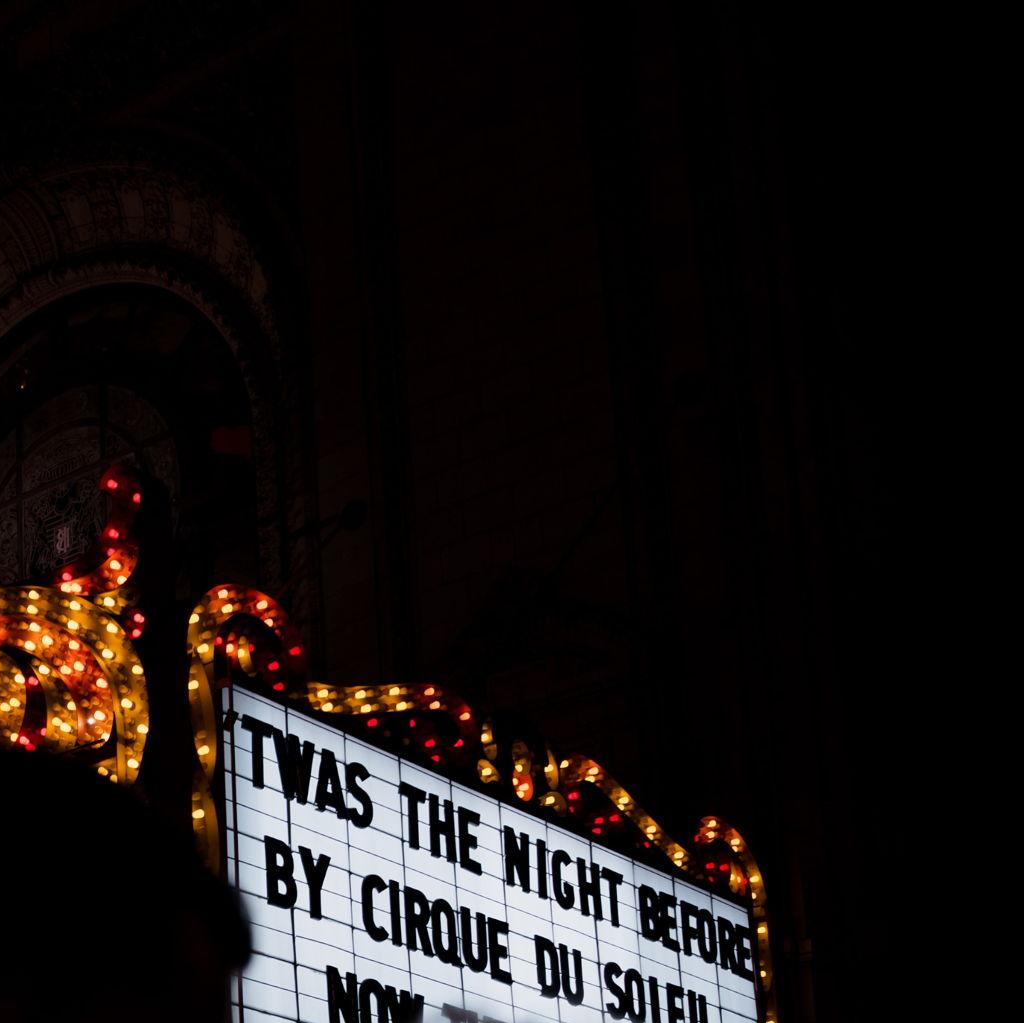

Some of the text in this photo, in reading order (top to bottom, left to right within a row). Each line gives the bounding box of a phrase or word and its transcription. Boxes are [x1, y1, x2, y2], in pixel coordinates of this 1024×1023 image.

[263, 835, 331, 920] BY
[361, 874, 513, 985] CIRQUE
[534, 934, 584, 1006] DU
[399, 781, 483, 876] THE
[503, 824, 624, 928] NIGHT
[639, 883, 755, 982] BEFORE
